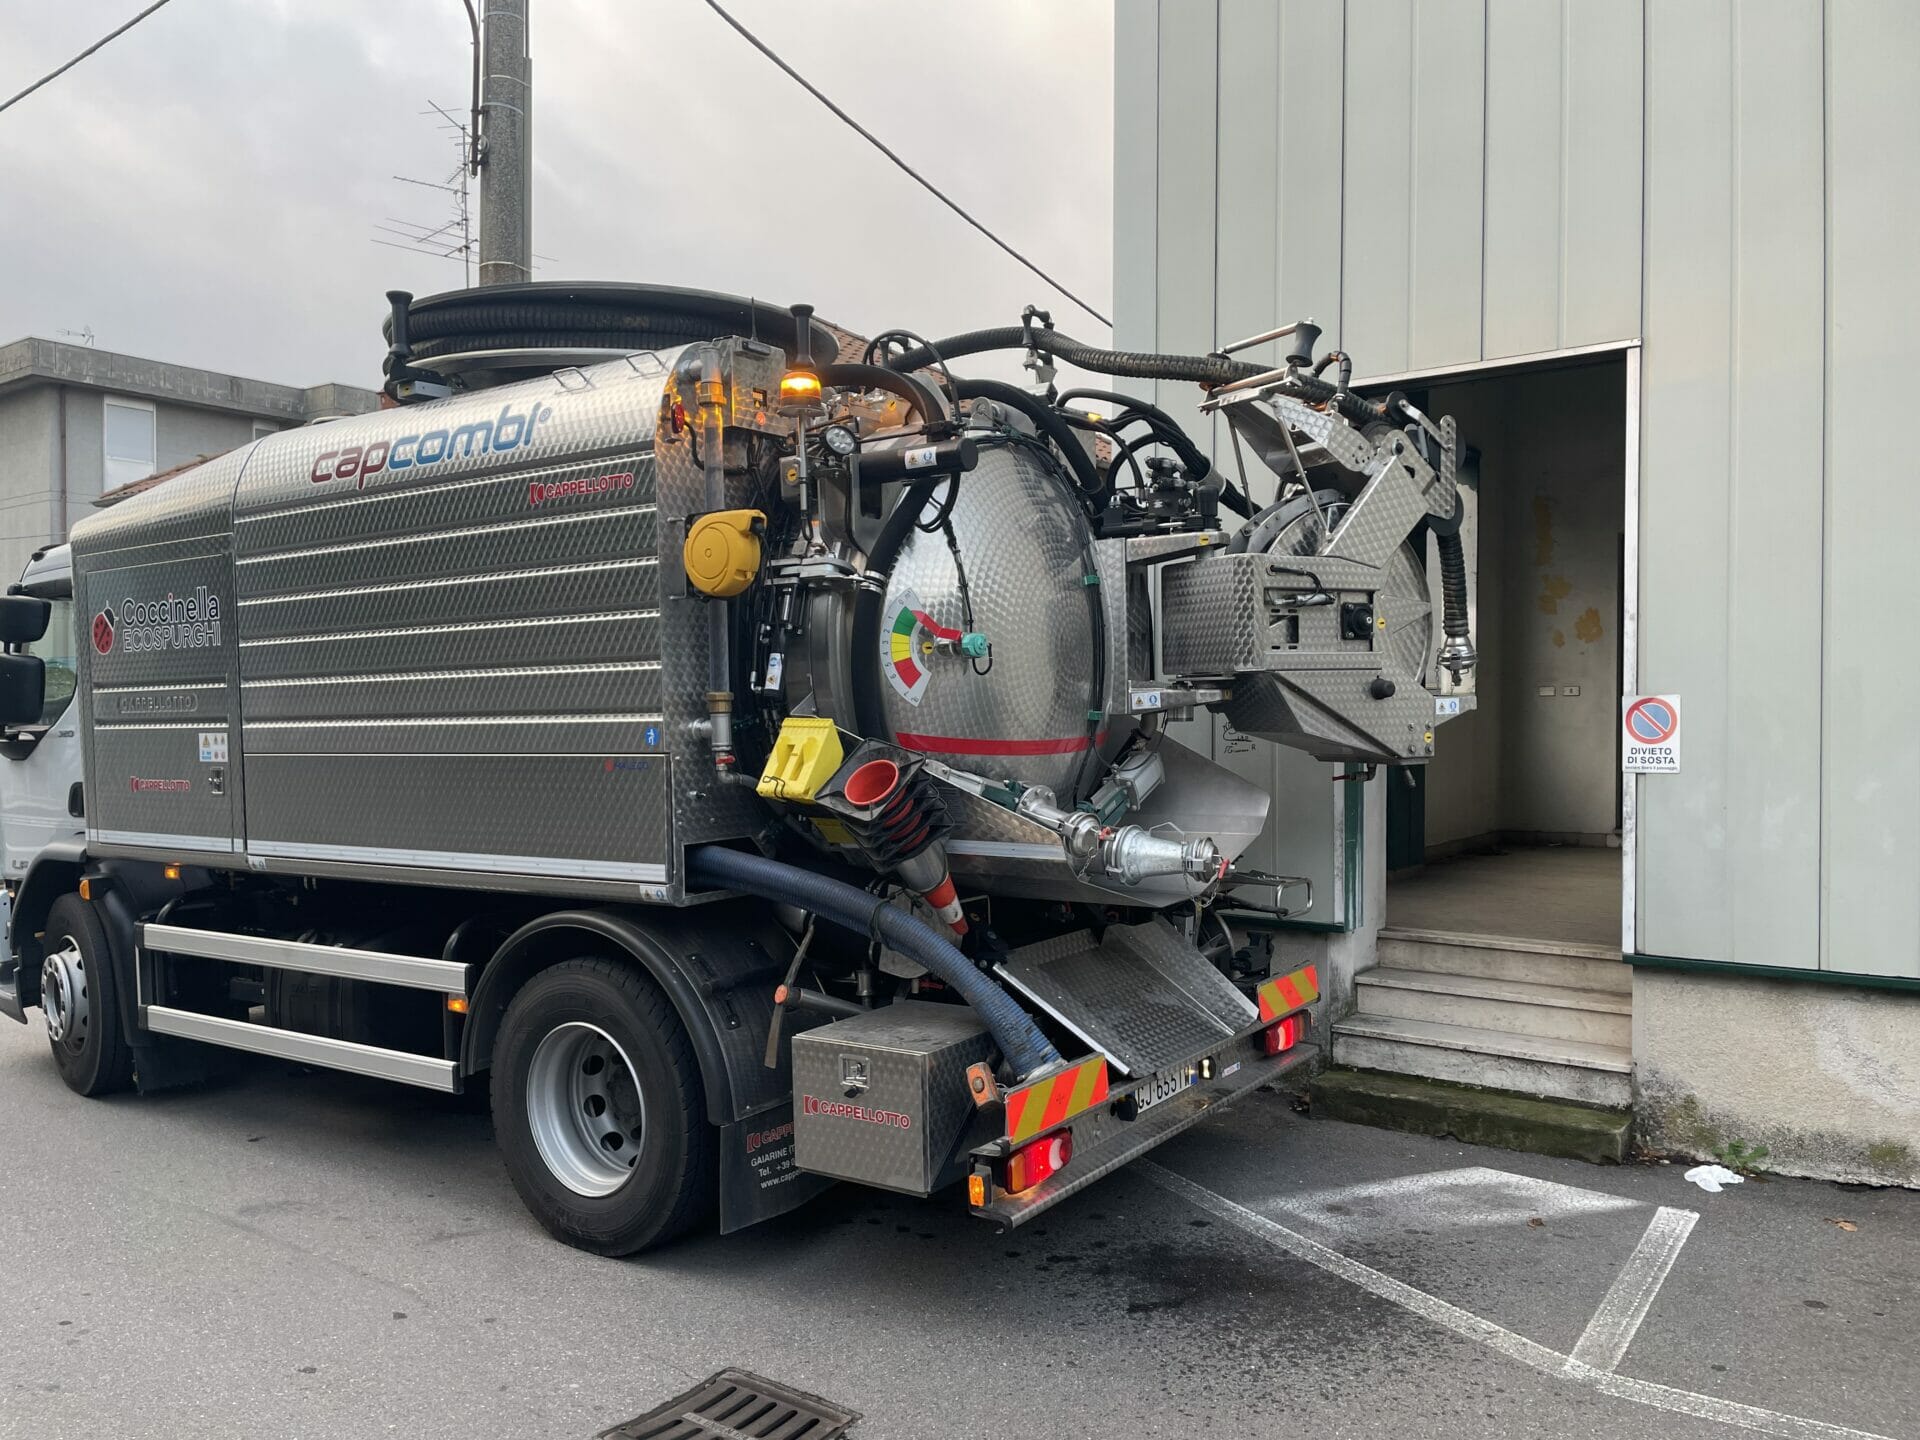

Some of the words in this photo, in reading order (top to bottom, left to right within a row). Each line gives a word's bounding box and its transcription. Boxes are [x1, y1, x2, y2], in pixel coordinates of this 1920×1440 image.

[546, 472, 633, 499] CAPPELLOTTO
[122, 586, 220, 628] Coccinella
[123, 621, 221, 653] ECOSPURGHI
[1627, 756, 1638, 764] DI
[1640, 756, 1675, 764] SOSTA
[1630, 747, 1672, 755] DIVIETO
[140, 778, 191, 792] CAPPELLOTTO
[821, 1100, 910, 1129] CAPPELLOTTO
[751, 1147, 788, 1167] GAIARINE
[758, 1166, 772, 1177] Tel.
[775, 1160, 790, 1170] +39
